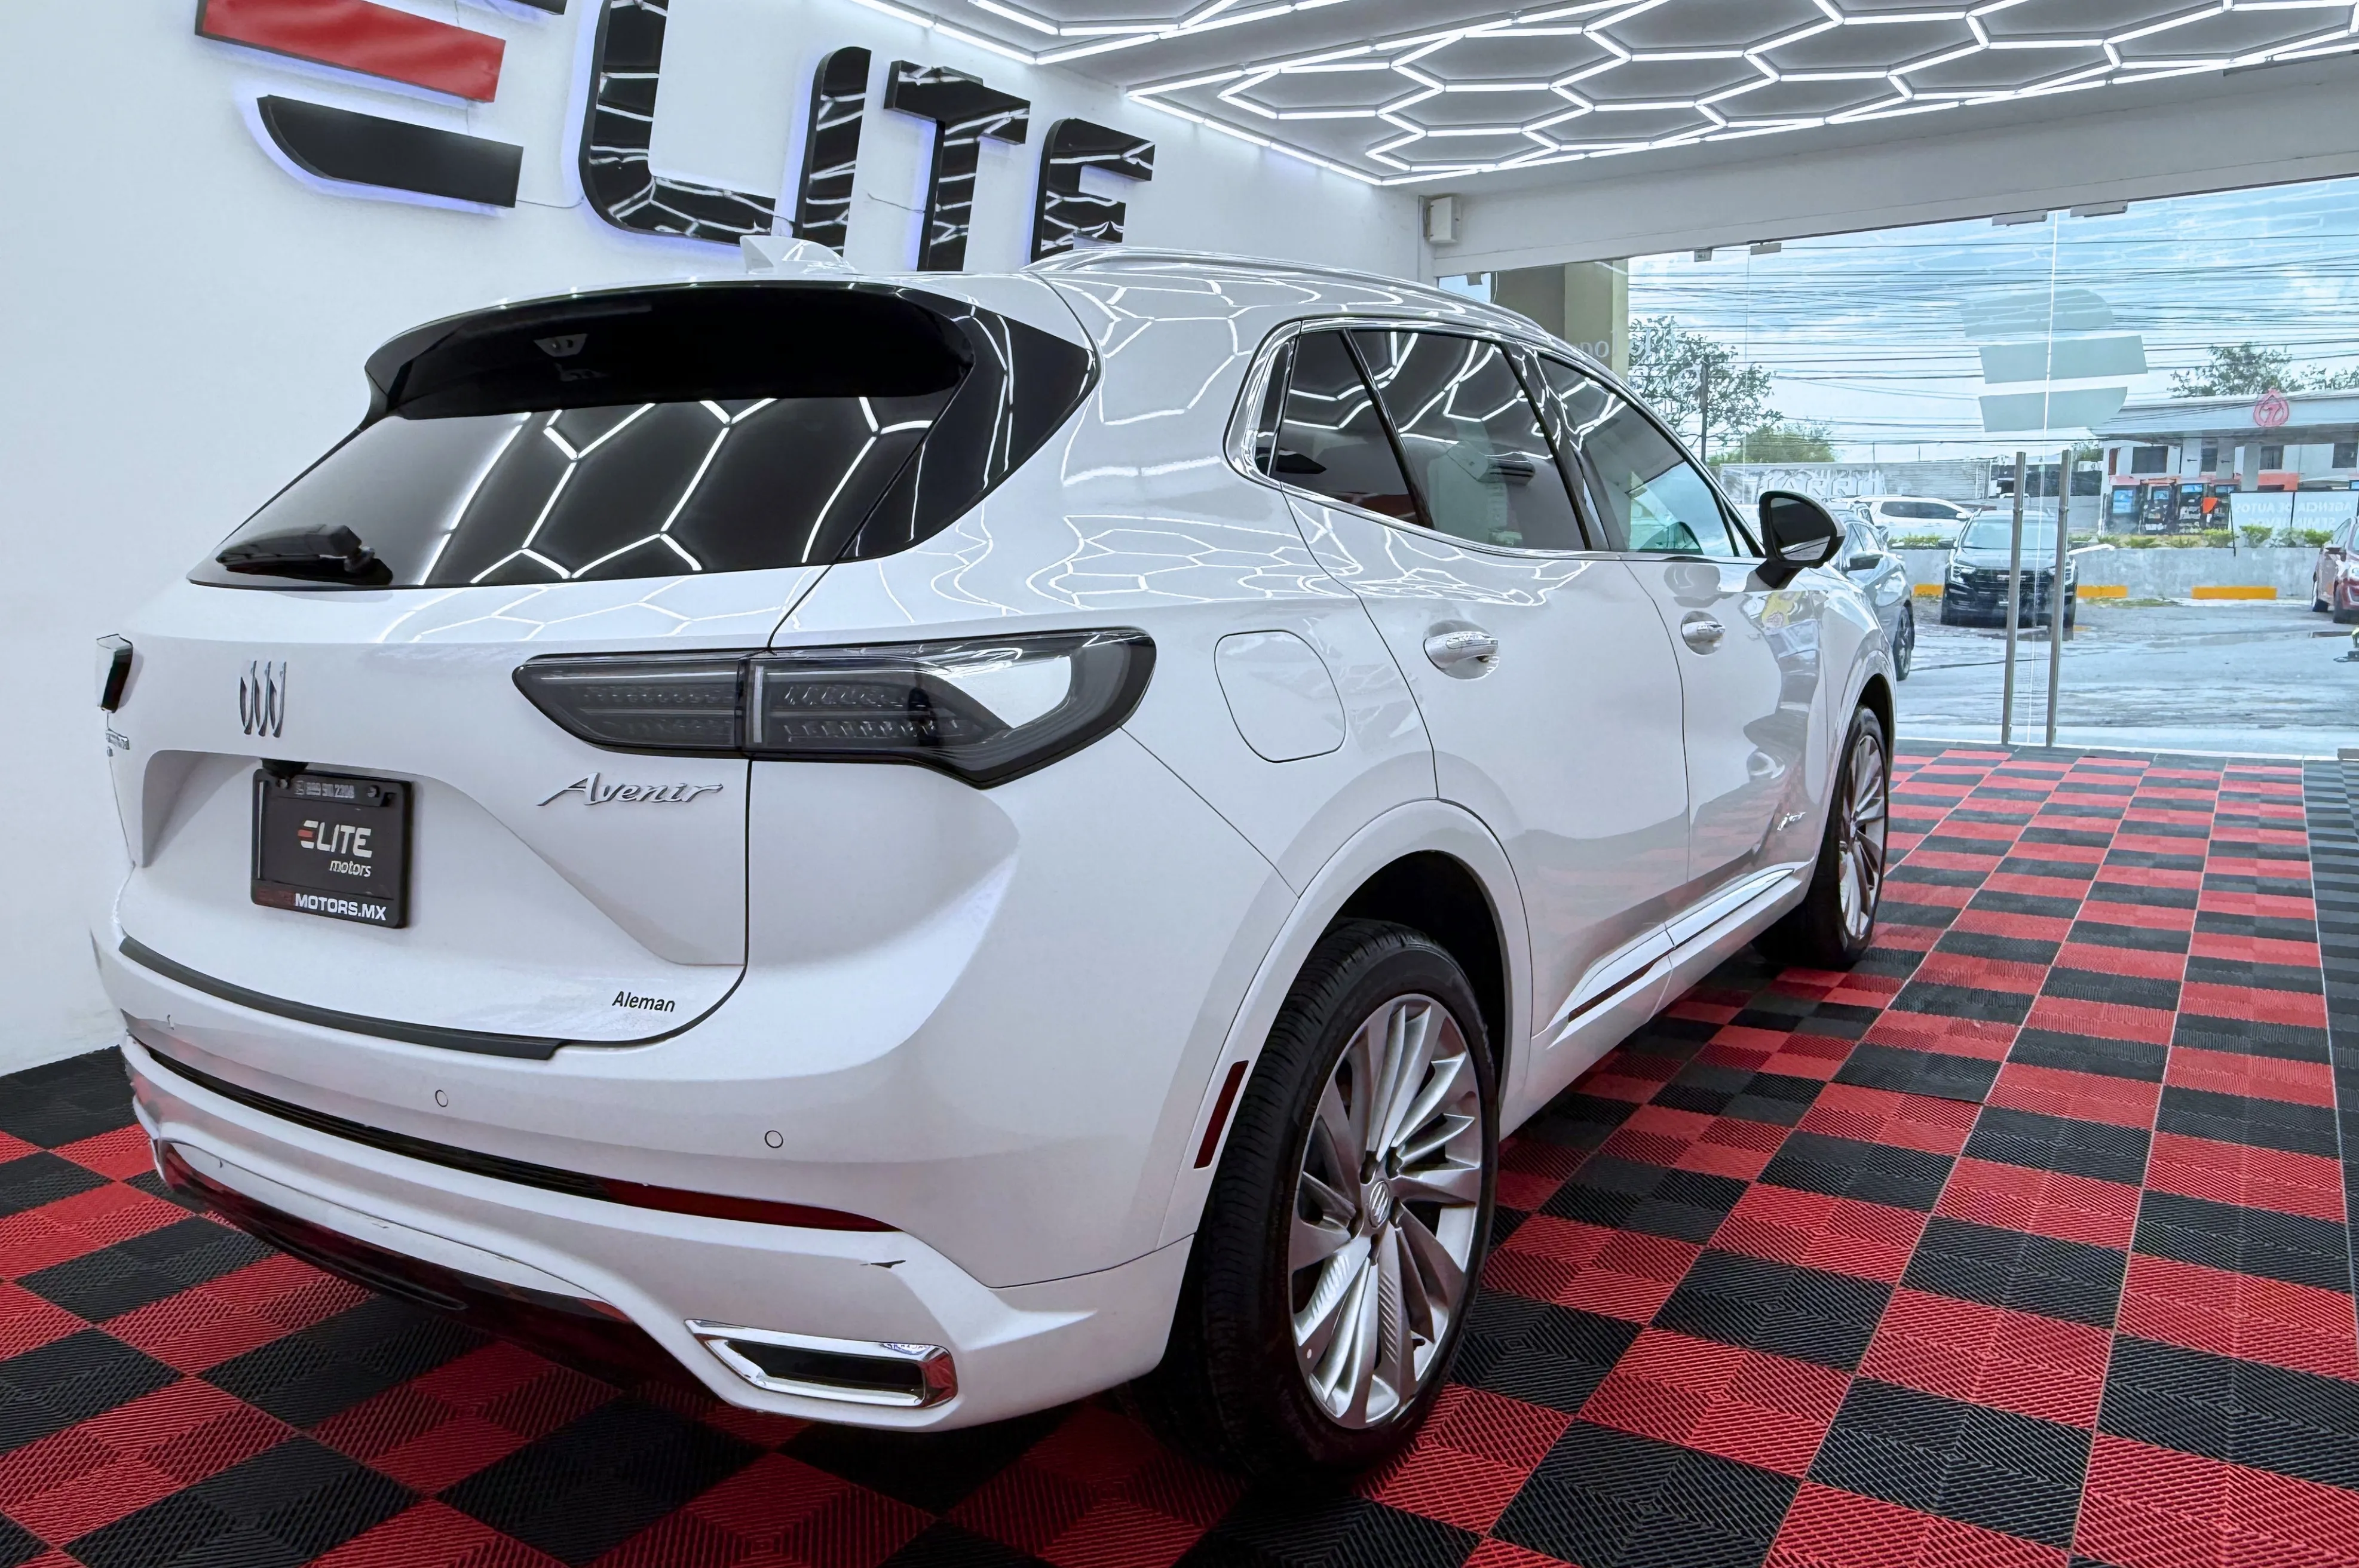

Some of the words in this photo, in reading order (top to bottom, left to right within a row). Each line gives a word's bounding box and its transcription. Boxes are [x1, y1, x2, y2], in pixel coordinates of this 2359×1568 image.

[195, 0, 1156, 272] ELITE
[537, 772, 724, 806] Avenir
[298, 820, 372, 858] ELITE
[329, 860, 372, 877] motors
[295, 892, 387, 920] MOTORS.MX
[611, 990, 675, 1012] Aleman
